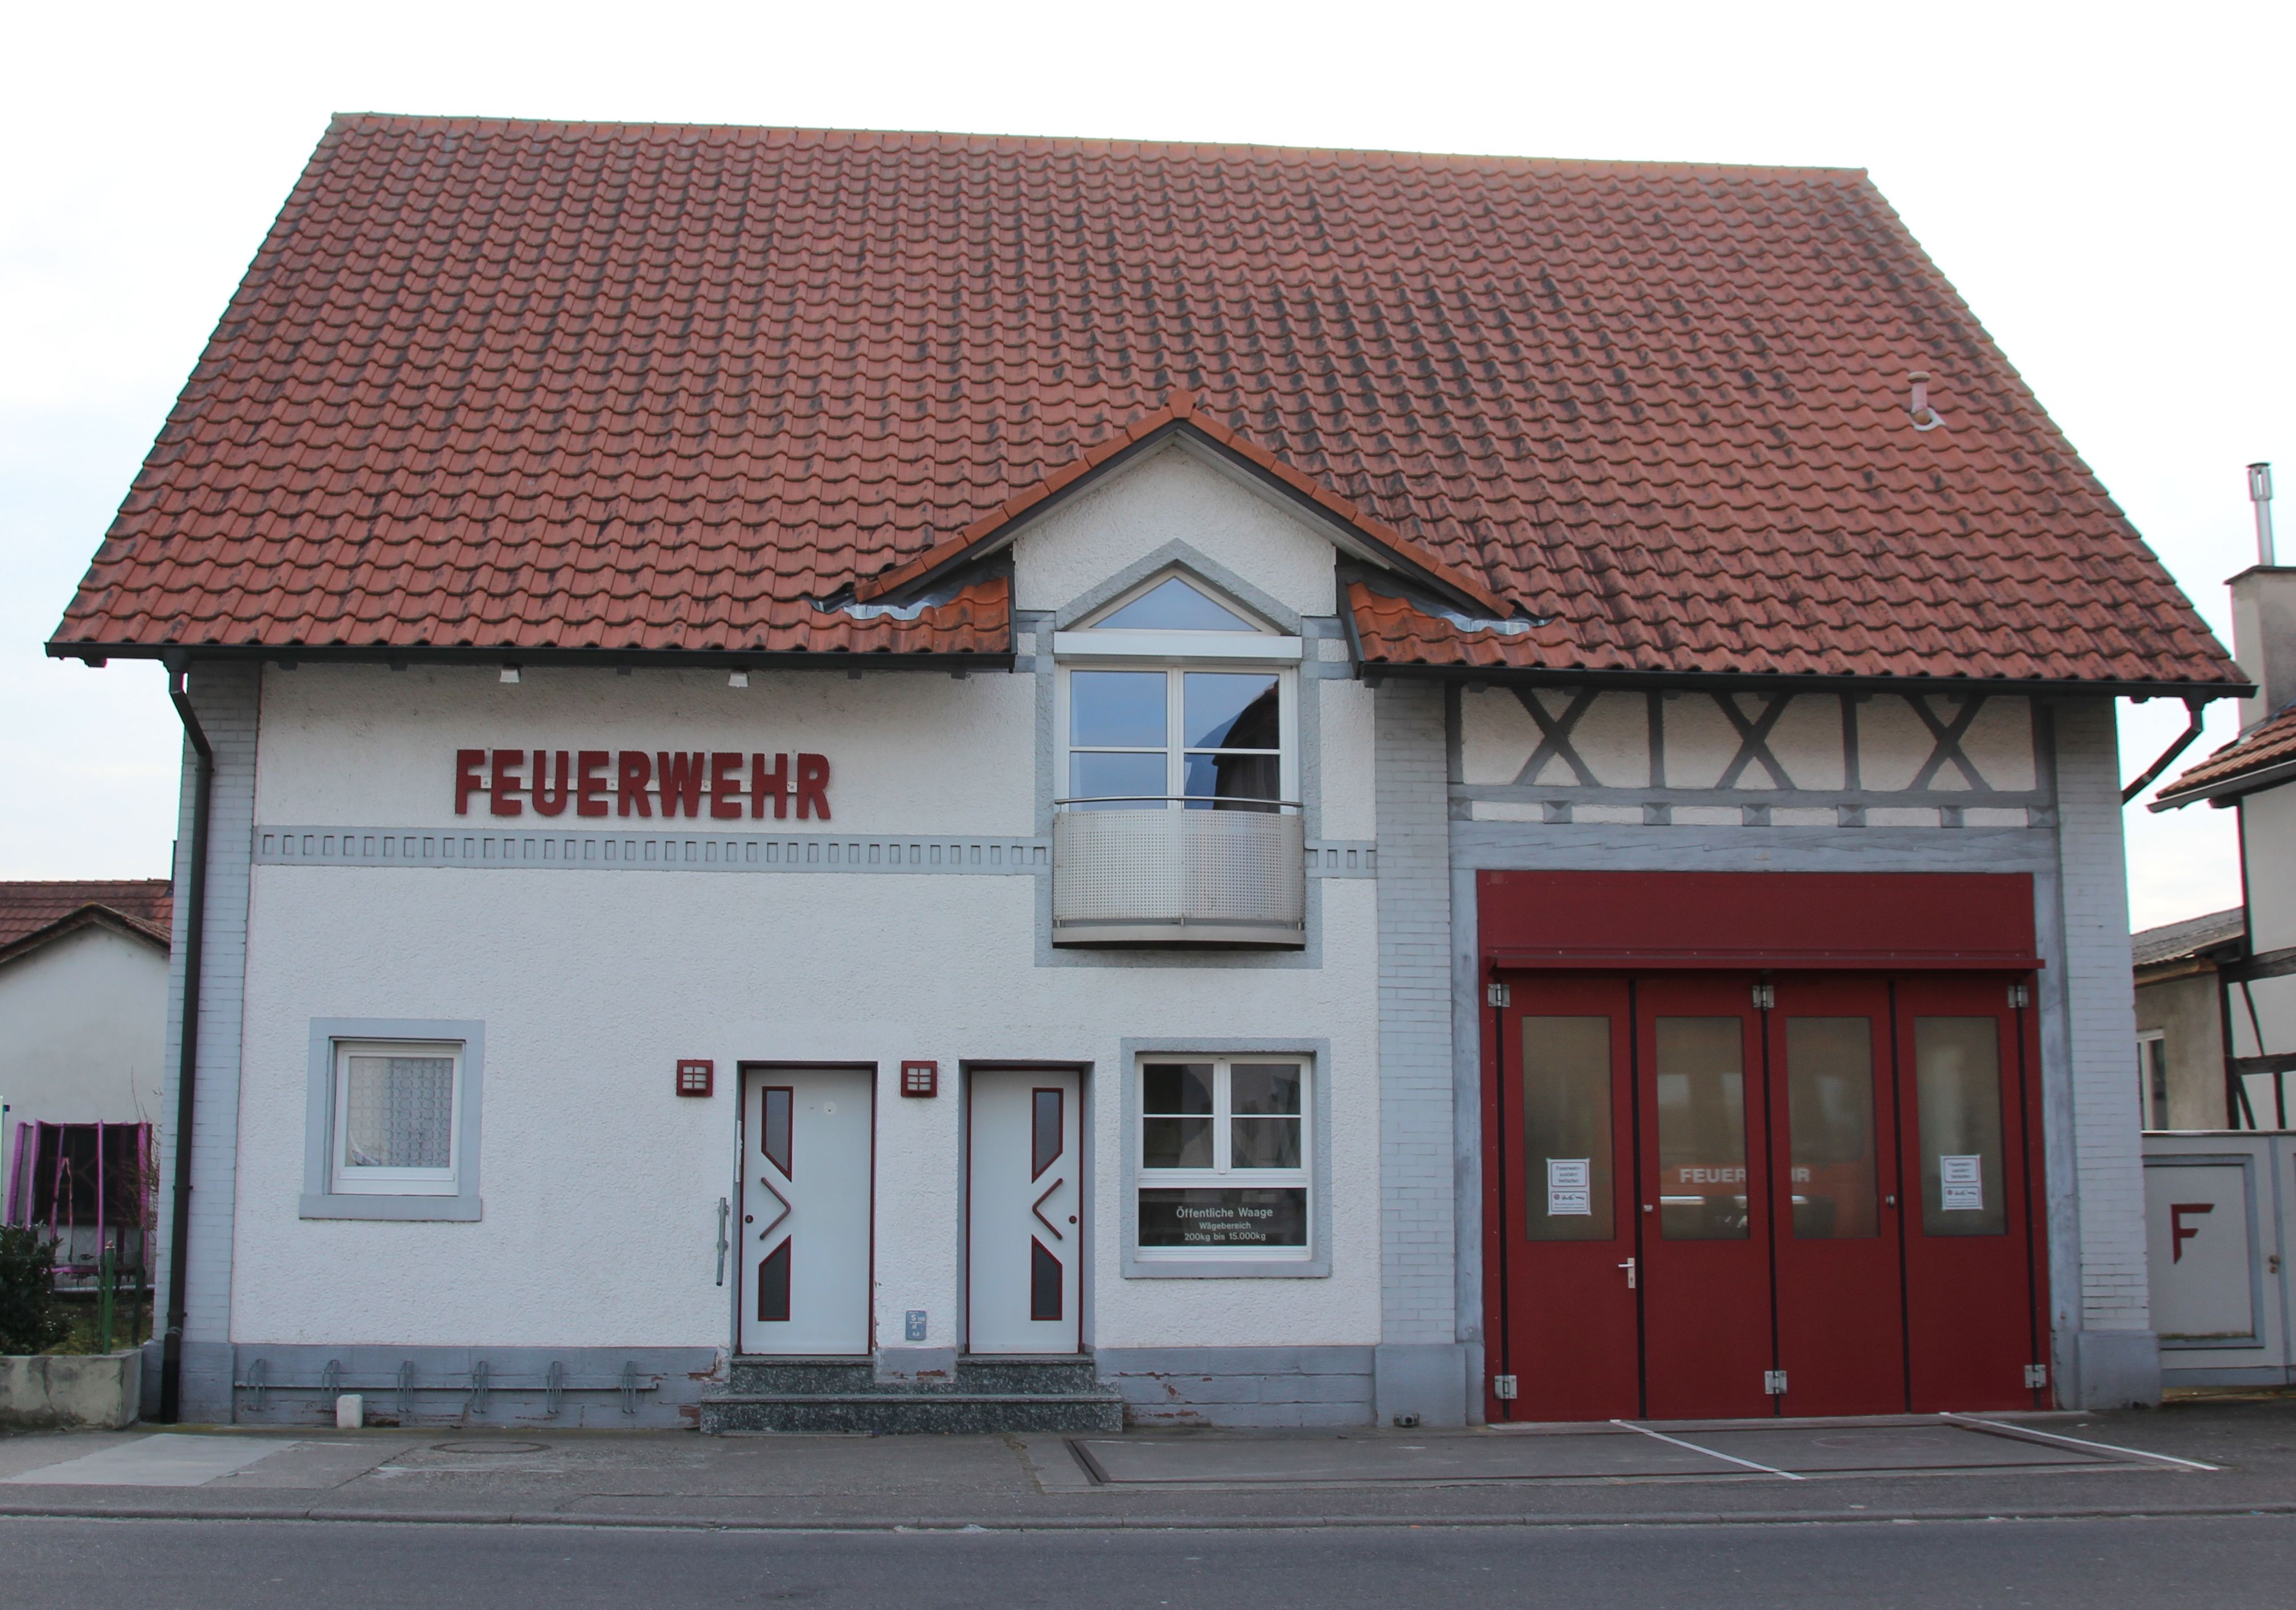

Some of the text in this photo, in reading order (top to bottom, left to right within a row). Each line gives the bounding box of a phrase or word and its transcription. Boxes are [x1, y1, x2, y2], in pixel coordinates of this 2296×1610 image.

[455, 749, 831, 820] FEUERWEHR
[1176, 1206, 1273, 1219] Öffentliche Waage
[1199, 1222, 1252, 1231] Wägebereich
[1184, 1232, 1211, 1242] 200kg
[1229, 1232, 1266, 1241] 15.000kg
[2170, 1203, 2214, 1264] F
